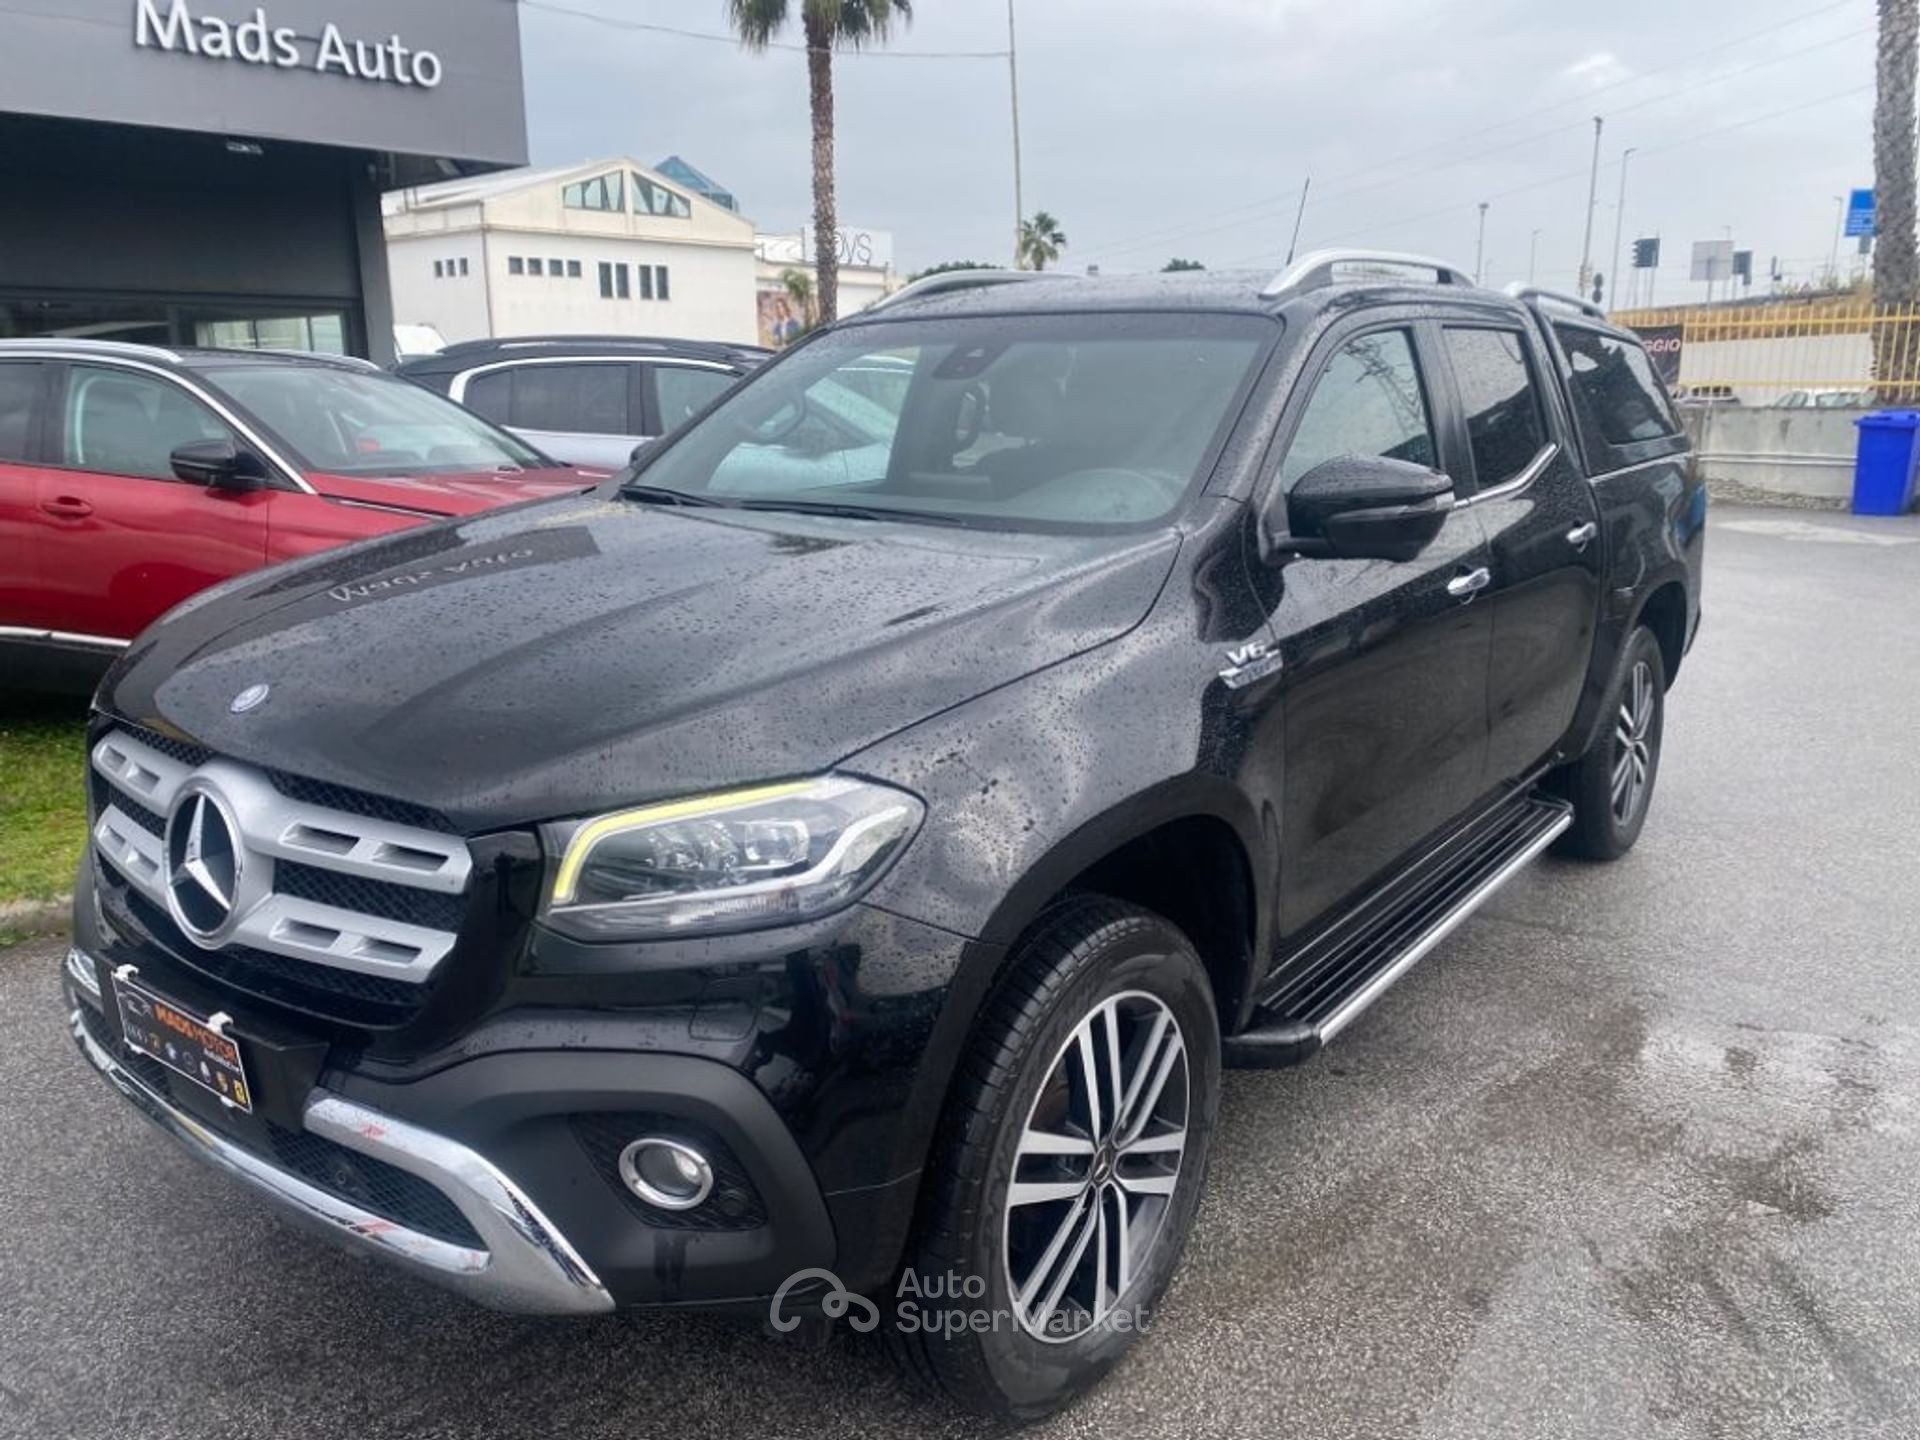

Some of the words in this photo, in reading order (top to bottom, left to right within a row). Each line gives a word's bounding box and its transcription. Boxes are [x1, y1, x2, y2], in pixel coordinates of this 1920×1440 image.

[136, 0, 300, 66] Mads
[315, 23, 442, 87] Auto
[1226, 642, 1266, 665] V6
